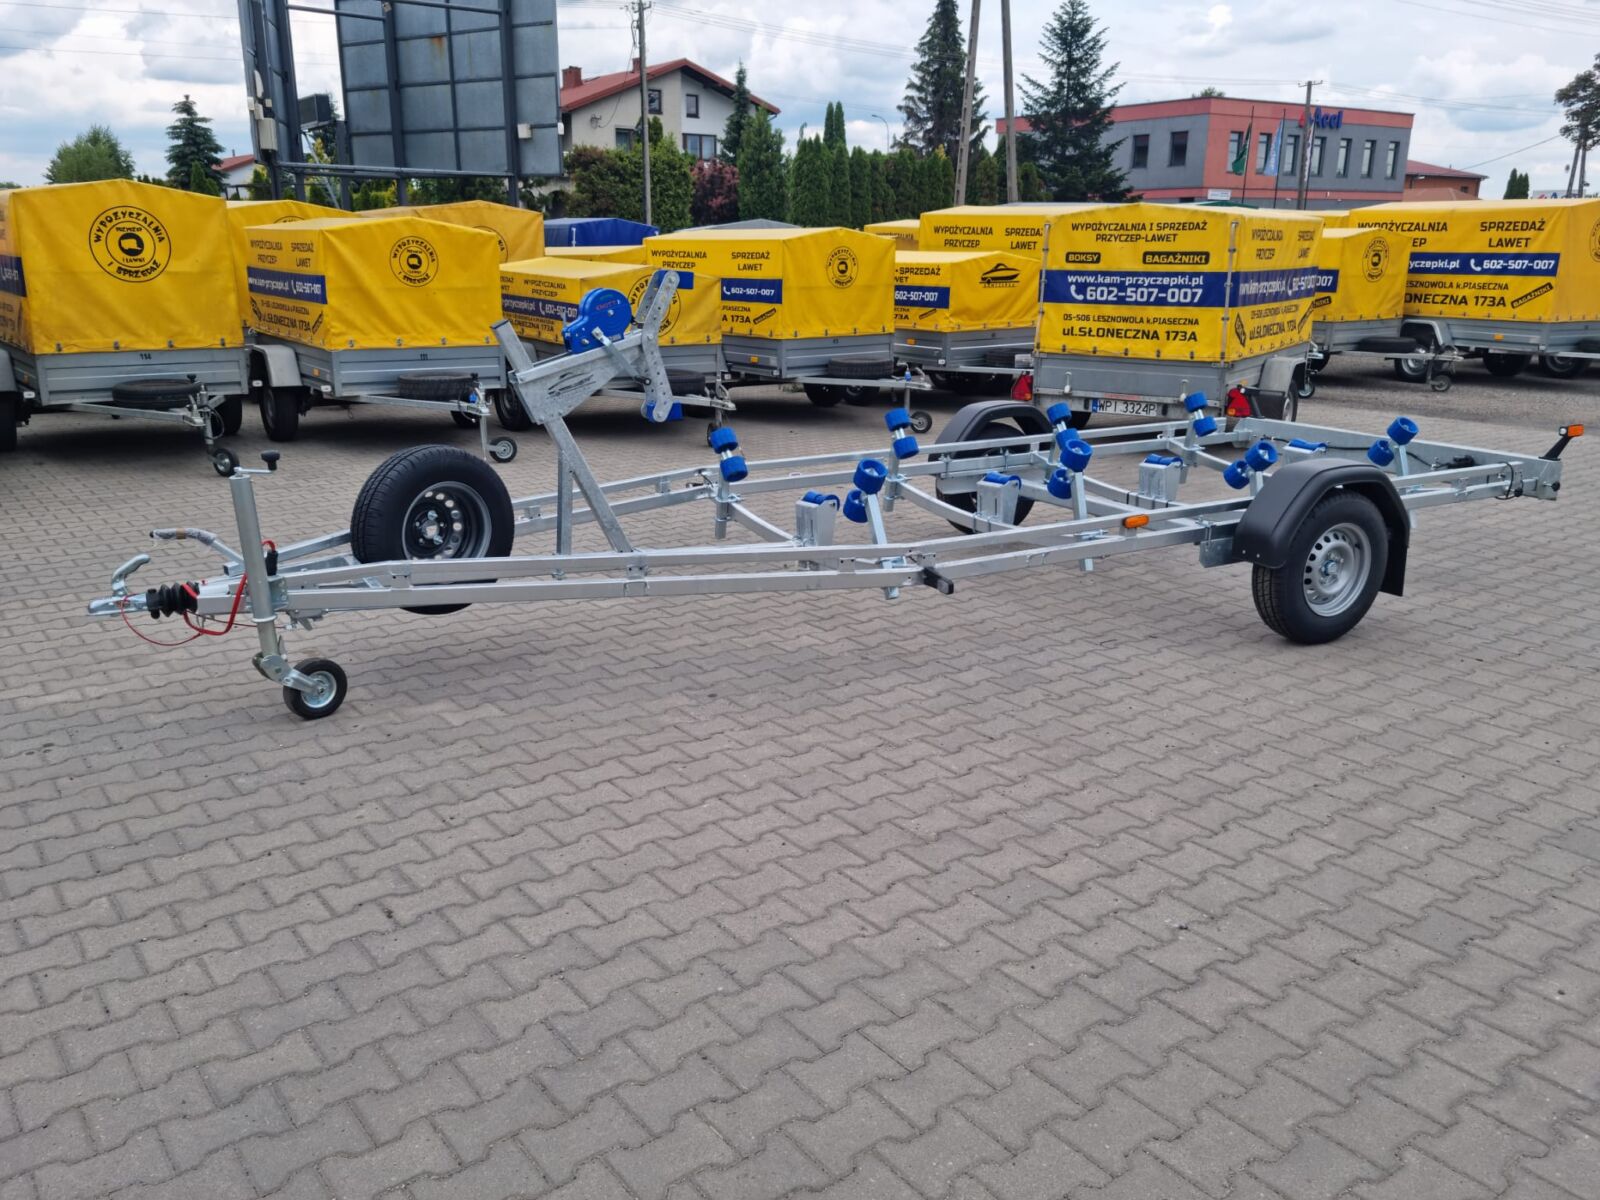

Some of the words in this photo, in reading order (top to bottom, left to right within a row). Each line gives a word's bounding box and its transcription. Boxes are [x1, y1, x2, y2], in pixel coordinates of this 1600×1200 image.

[934, 225, 993, 235] WYPOŻYCZALNIA
[1005, 228, 1043, 236] SPRZEDA
[1072, 221, 1146, 231] WYPOŻYCZALNIA
[1150, 223, 1153, 231] I
[1156, 220, 1208, 231] SPRZEDAŻ
[1480, 218, 1546, 232] SPRZEDAŻ
[1096, 234, 1178, 242] PRZYCZEP-LAWET
[1489, 238, 1531, 248] LAWET
[944, 239, 980, 248] PRZYCZEP
[1010, 241, 1037, 250] LAWET
[652, 249, 707, 259] WYPOŻYCZALNIA
[732, 250, 770, 259] SPRZEDAŻ
[1146, 253, 1206, 264] BAGAŻNIKI
[900, 265, 941, 275] SPRZEDAŻ
[1483, 260, 1555, 270] 602-507-007
[1067, 274, 1204, 287] www.kam-przyczepki.pl
[1456, 281, 1509, 290] k.PIASECZNA
[731, 287, 775, 296] 602-507-007
[1086, 286, 1203, 303] 602-507-007
[1474, 296, 1506, 307] 173A
[731, 315, 751, 323] 173A
[1063, 313, 1091, 322] 05-506
[1093, 314, 1144, 324] LESZNOWOLA
[1146, 316, 1199, 325] k.PIASECZNA
[1062, 326, 1160, 340] ul.SŁONECZNA
[1166, 330, 1198, 341] 173A
[1123, 401, 1156, 415] 3324P
